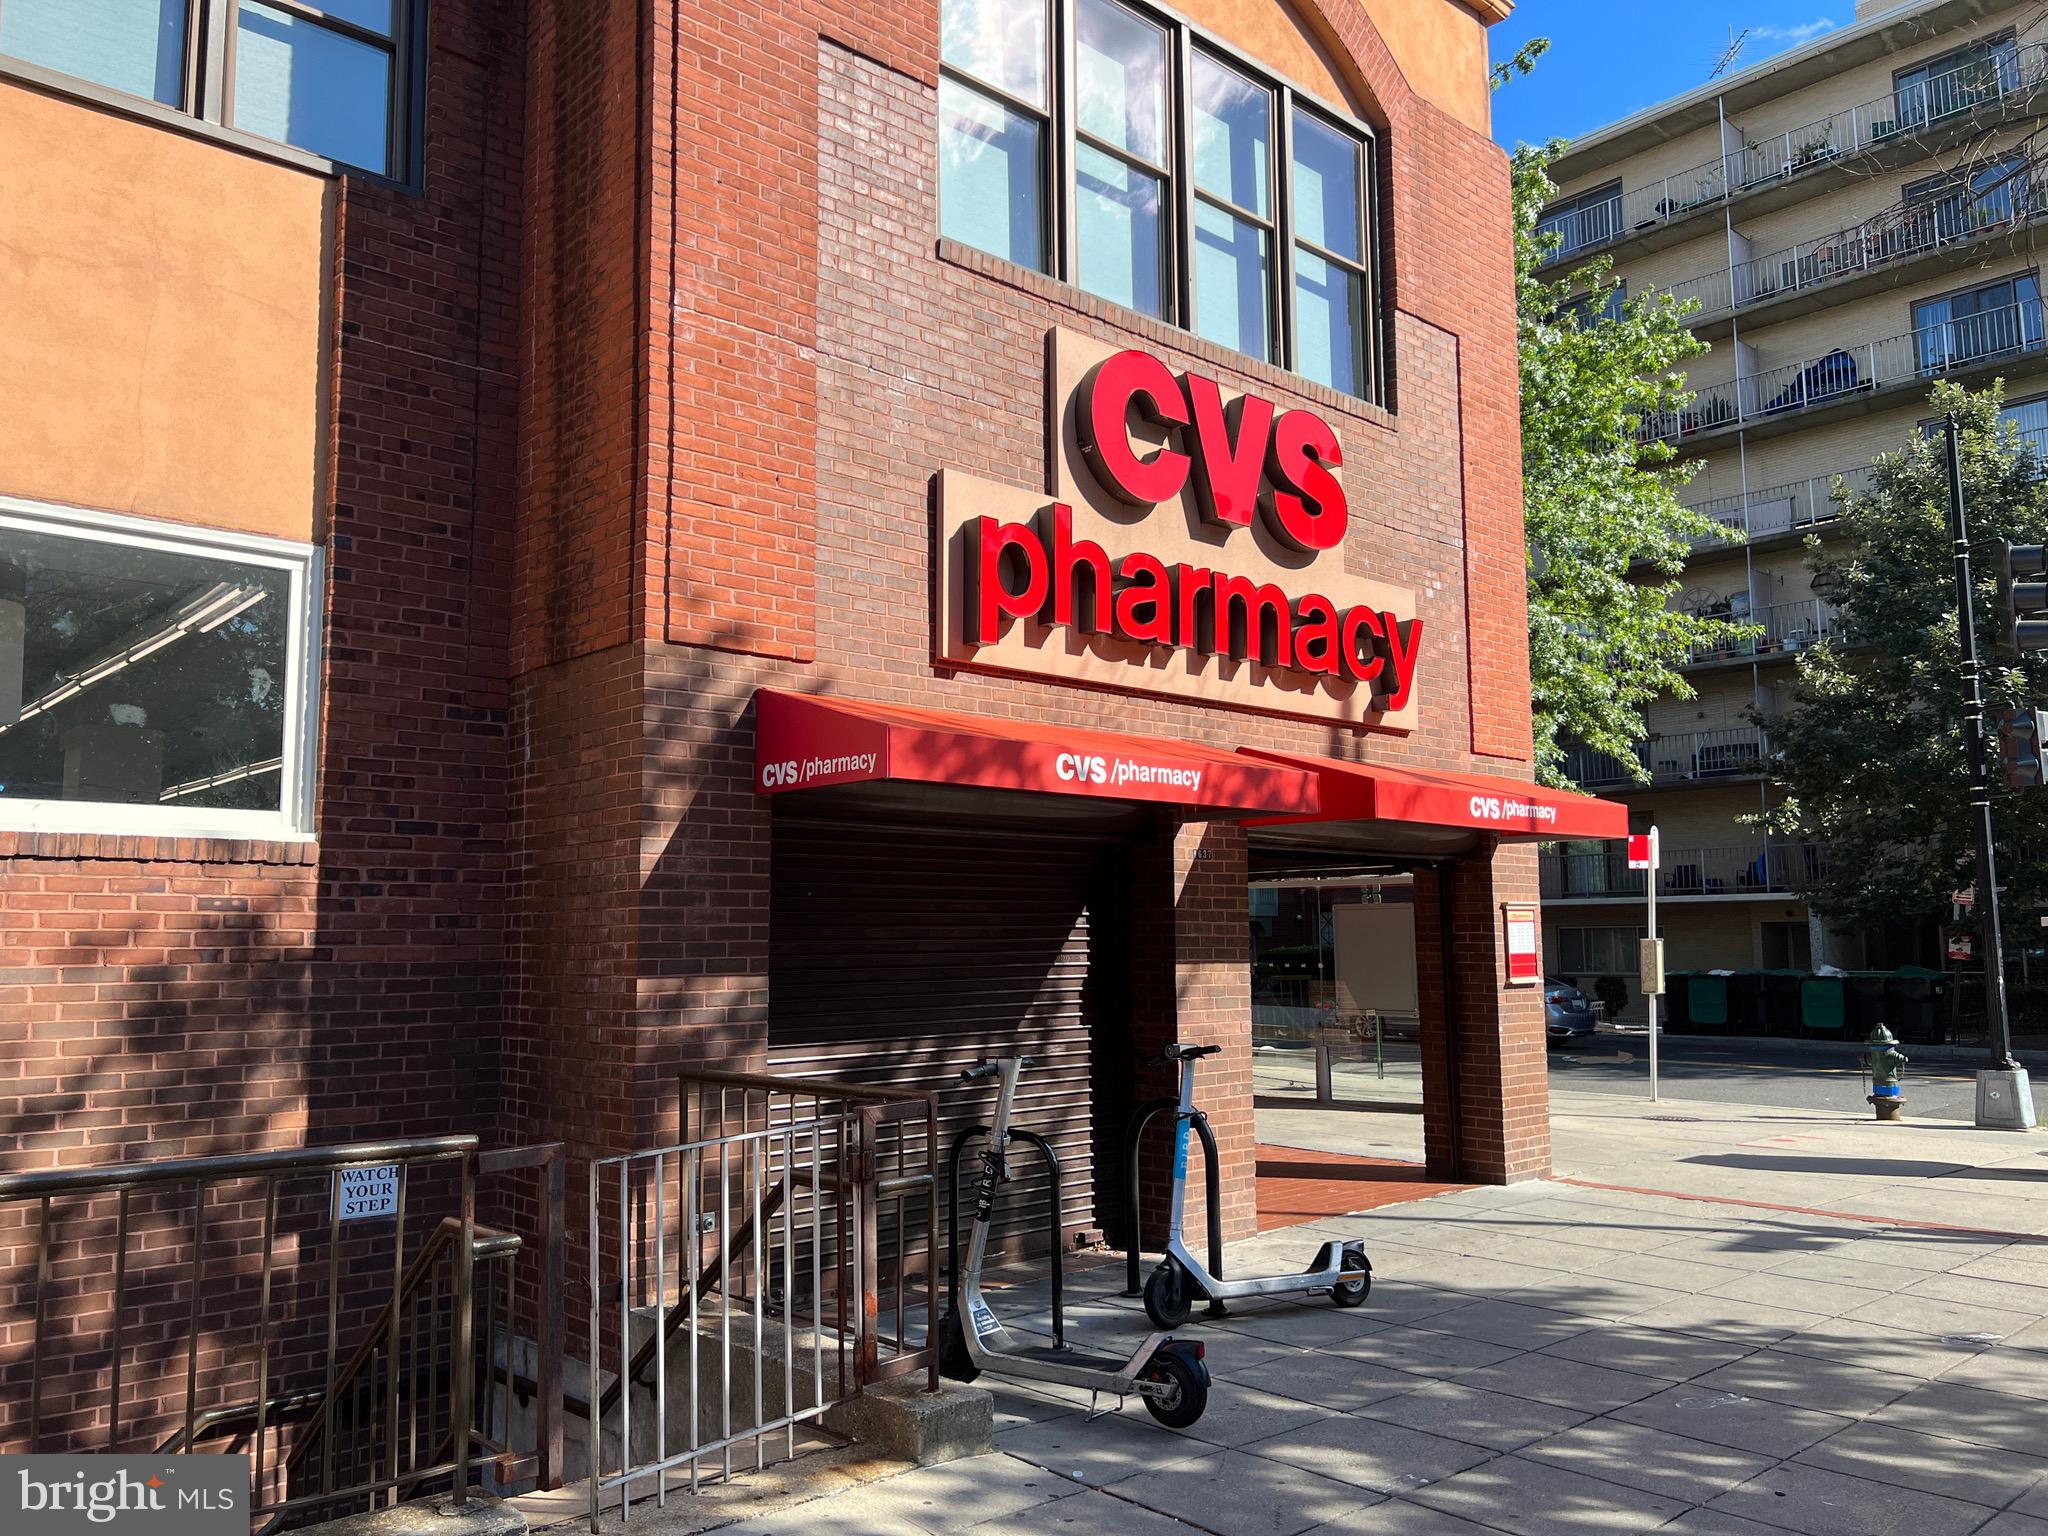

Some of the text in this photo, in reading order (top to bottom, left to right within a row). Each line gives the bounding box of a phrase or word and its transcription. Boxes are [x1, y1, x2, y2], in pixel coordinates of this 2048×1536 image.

[1090, 349, 1348, 551] CVS
[978, 501, 1424, 711] pharmacy
[762, 760, 798, 788] CVS
[1055, 752, 1107, 784] CVS
[1470, 795, 1500, 820] CVS
[341, 1167, 398, 1183] WATCH
[346, 1183, 392, 1198] YOUR
[345, 1198, 391, 1214] STEP
